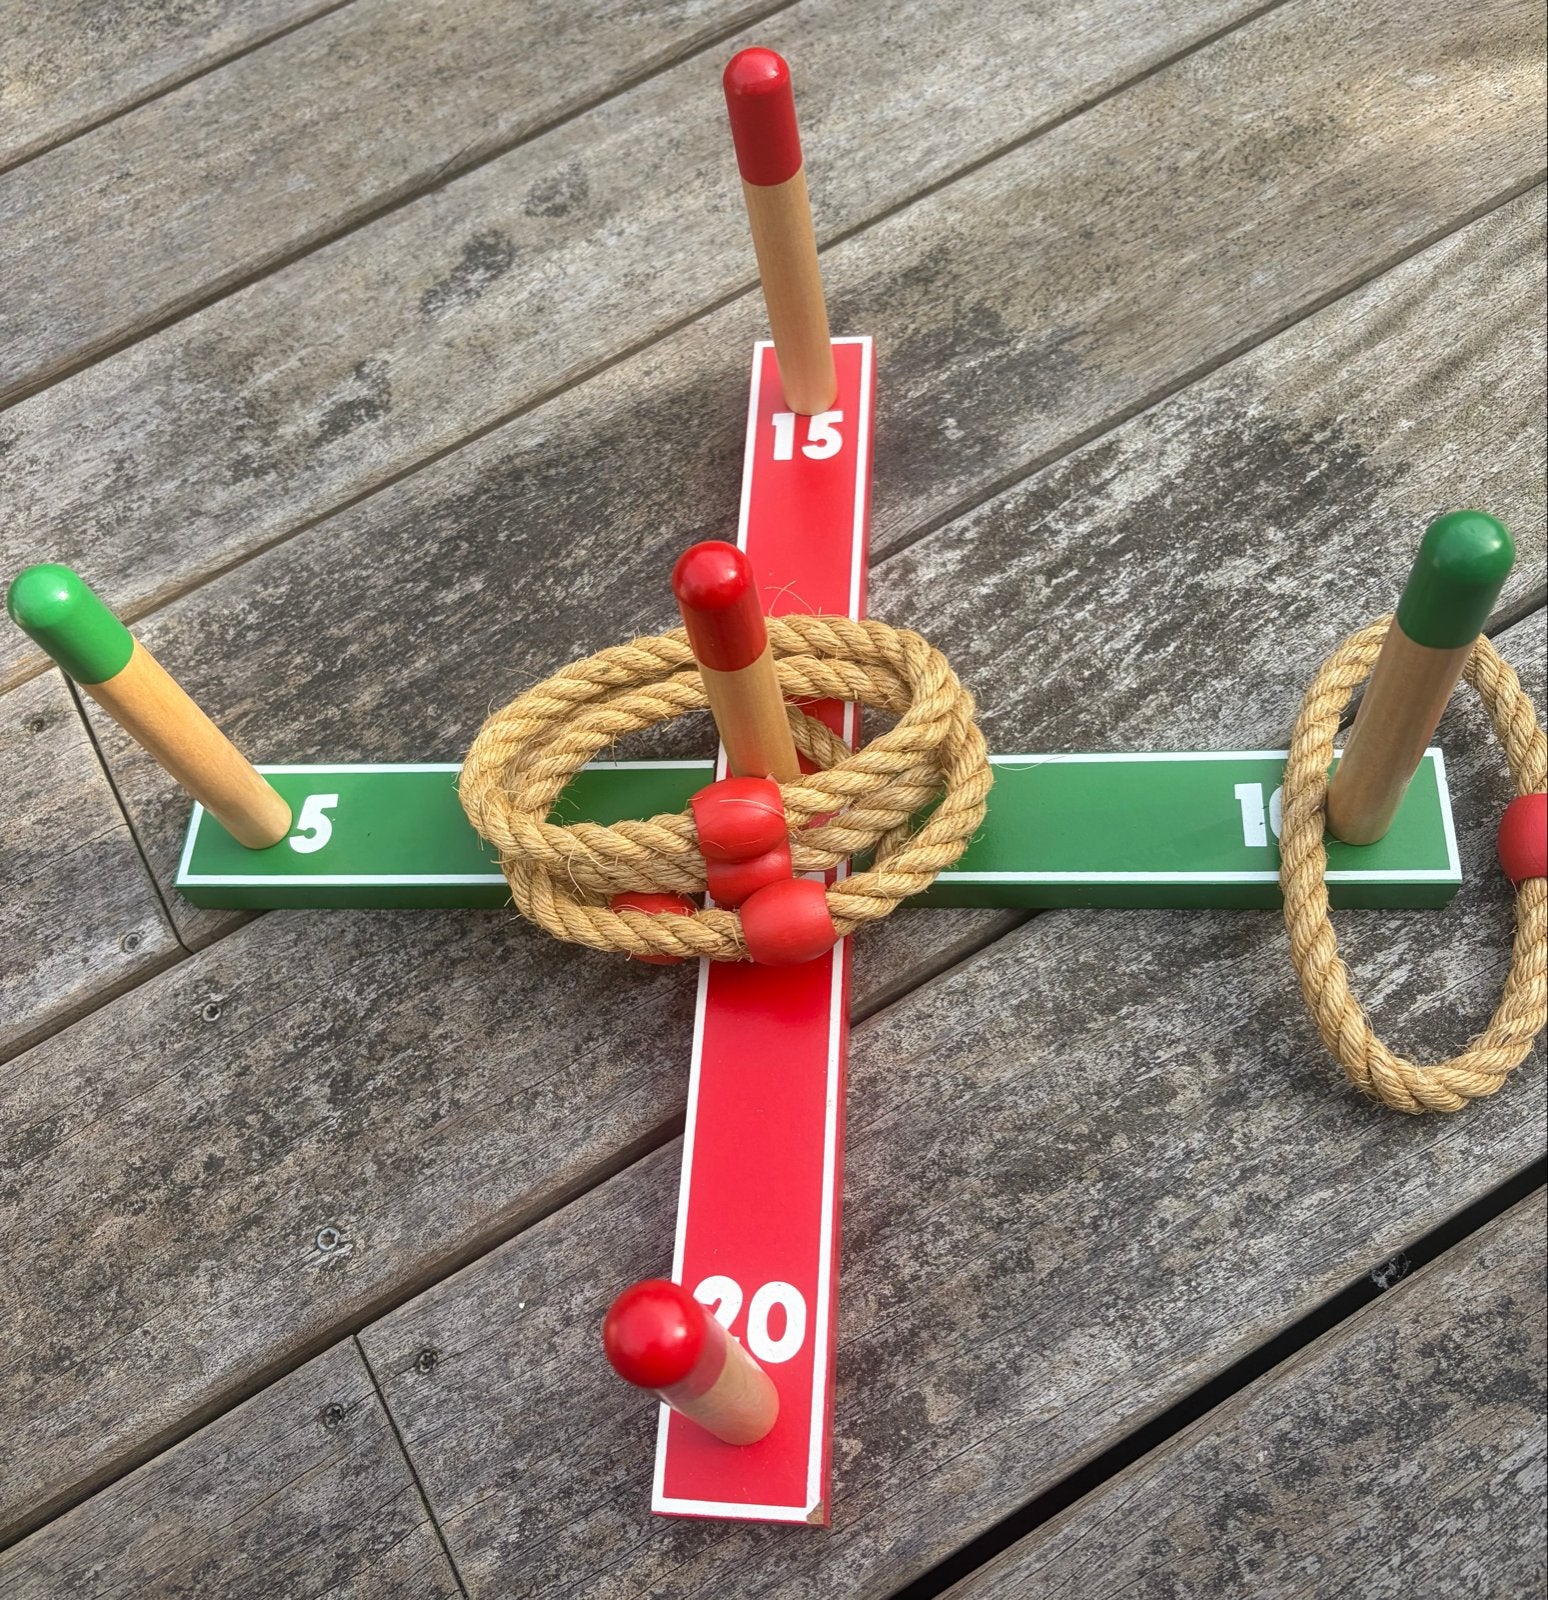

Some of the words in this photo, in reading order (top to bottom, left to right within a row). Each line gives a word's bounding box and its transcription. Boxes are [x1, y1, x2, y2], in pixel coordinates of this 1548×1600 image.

[771, 409, 844, 461] 15
[288, 792, 340, 854] 5
[692, 1275, 807, 1364] 20
